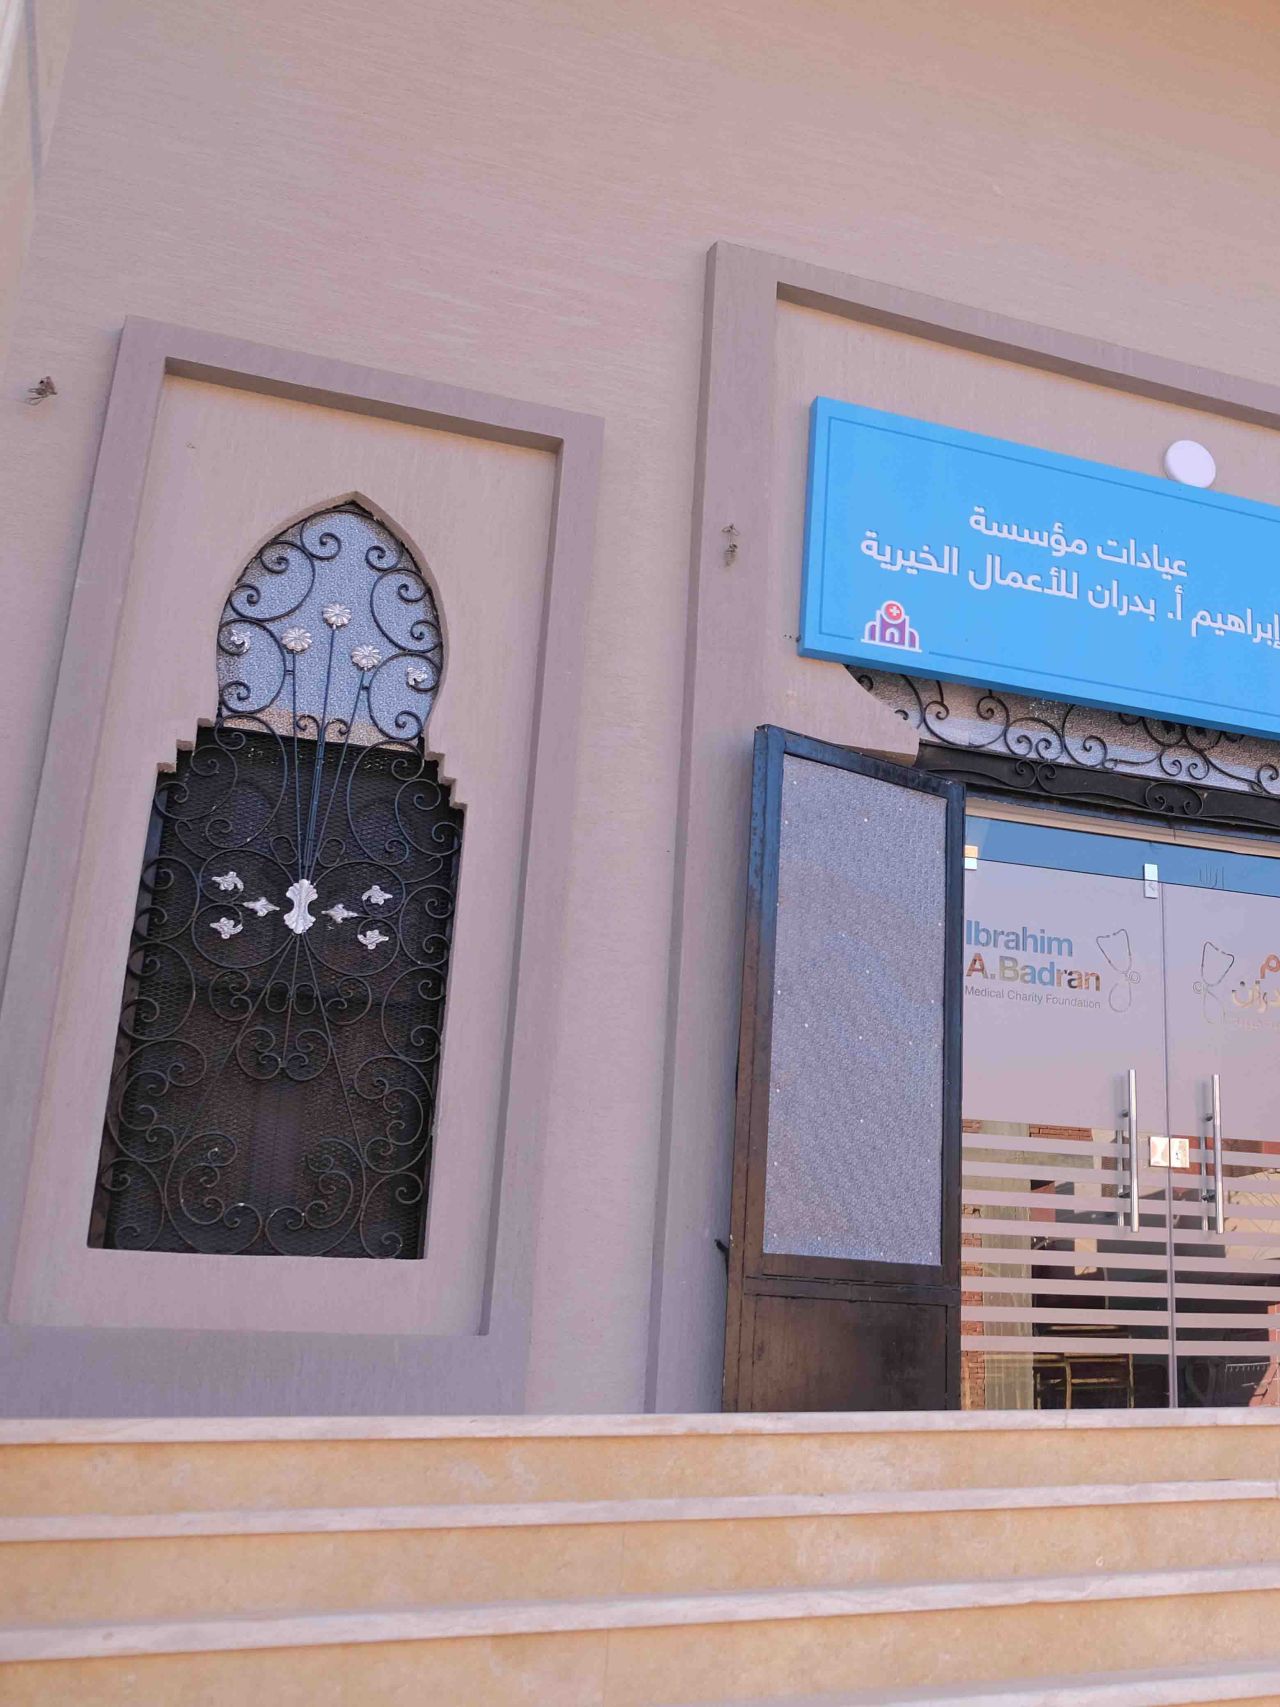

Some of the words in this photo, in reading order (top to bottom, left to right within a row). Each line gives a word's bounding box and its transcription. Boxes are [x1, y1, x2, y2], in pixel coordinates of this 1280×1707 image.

[969, 506, 1089, 557] مؤسسة
[861, 530, 959, 576] الخيرية
[1096, 538, 1188, 580] عيادات
[968, 554, 1078, 600] للأعمال
[1088, 579, 1156, 622] بدران
[1191, 608, 1280, 649] إبراهيم
[965, 920, 1073, 957] Ibrahim
[964, 985, 1004, 999] Medical
[1007, 989, 1043, 1005] Charity
[1046, 993, 1100, 1009] Foundation
